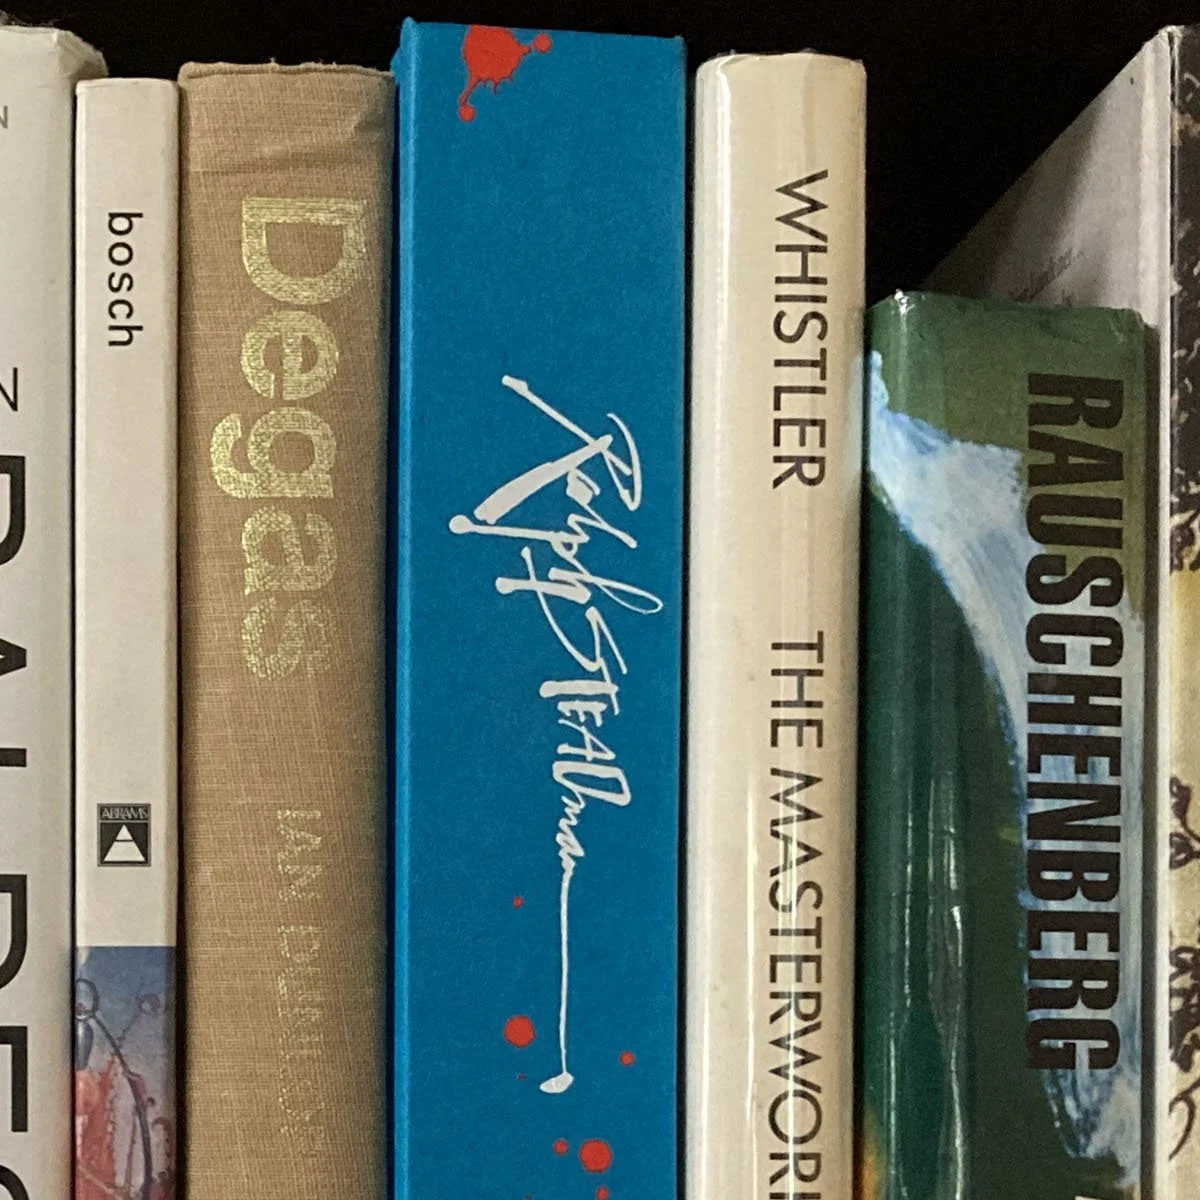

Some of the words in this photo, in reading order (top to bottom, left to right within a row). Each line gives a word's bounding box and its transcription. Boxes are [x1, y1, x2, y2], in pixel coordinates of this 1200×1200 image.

[107, 211, 143, 347] bosch
[772, 169, 829, 490] WHISTLER
[210, 197, 366, 679] Degas
[770, 631, 823, 748] THE
[1024, 372, 1125, 1072] RAUSCHENBERG
[102, 807, 147, 819] ABRAMS
